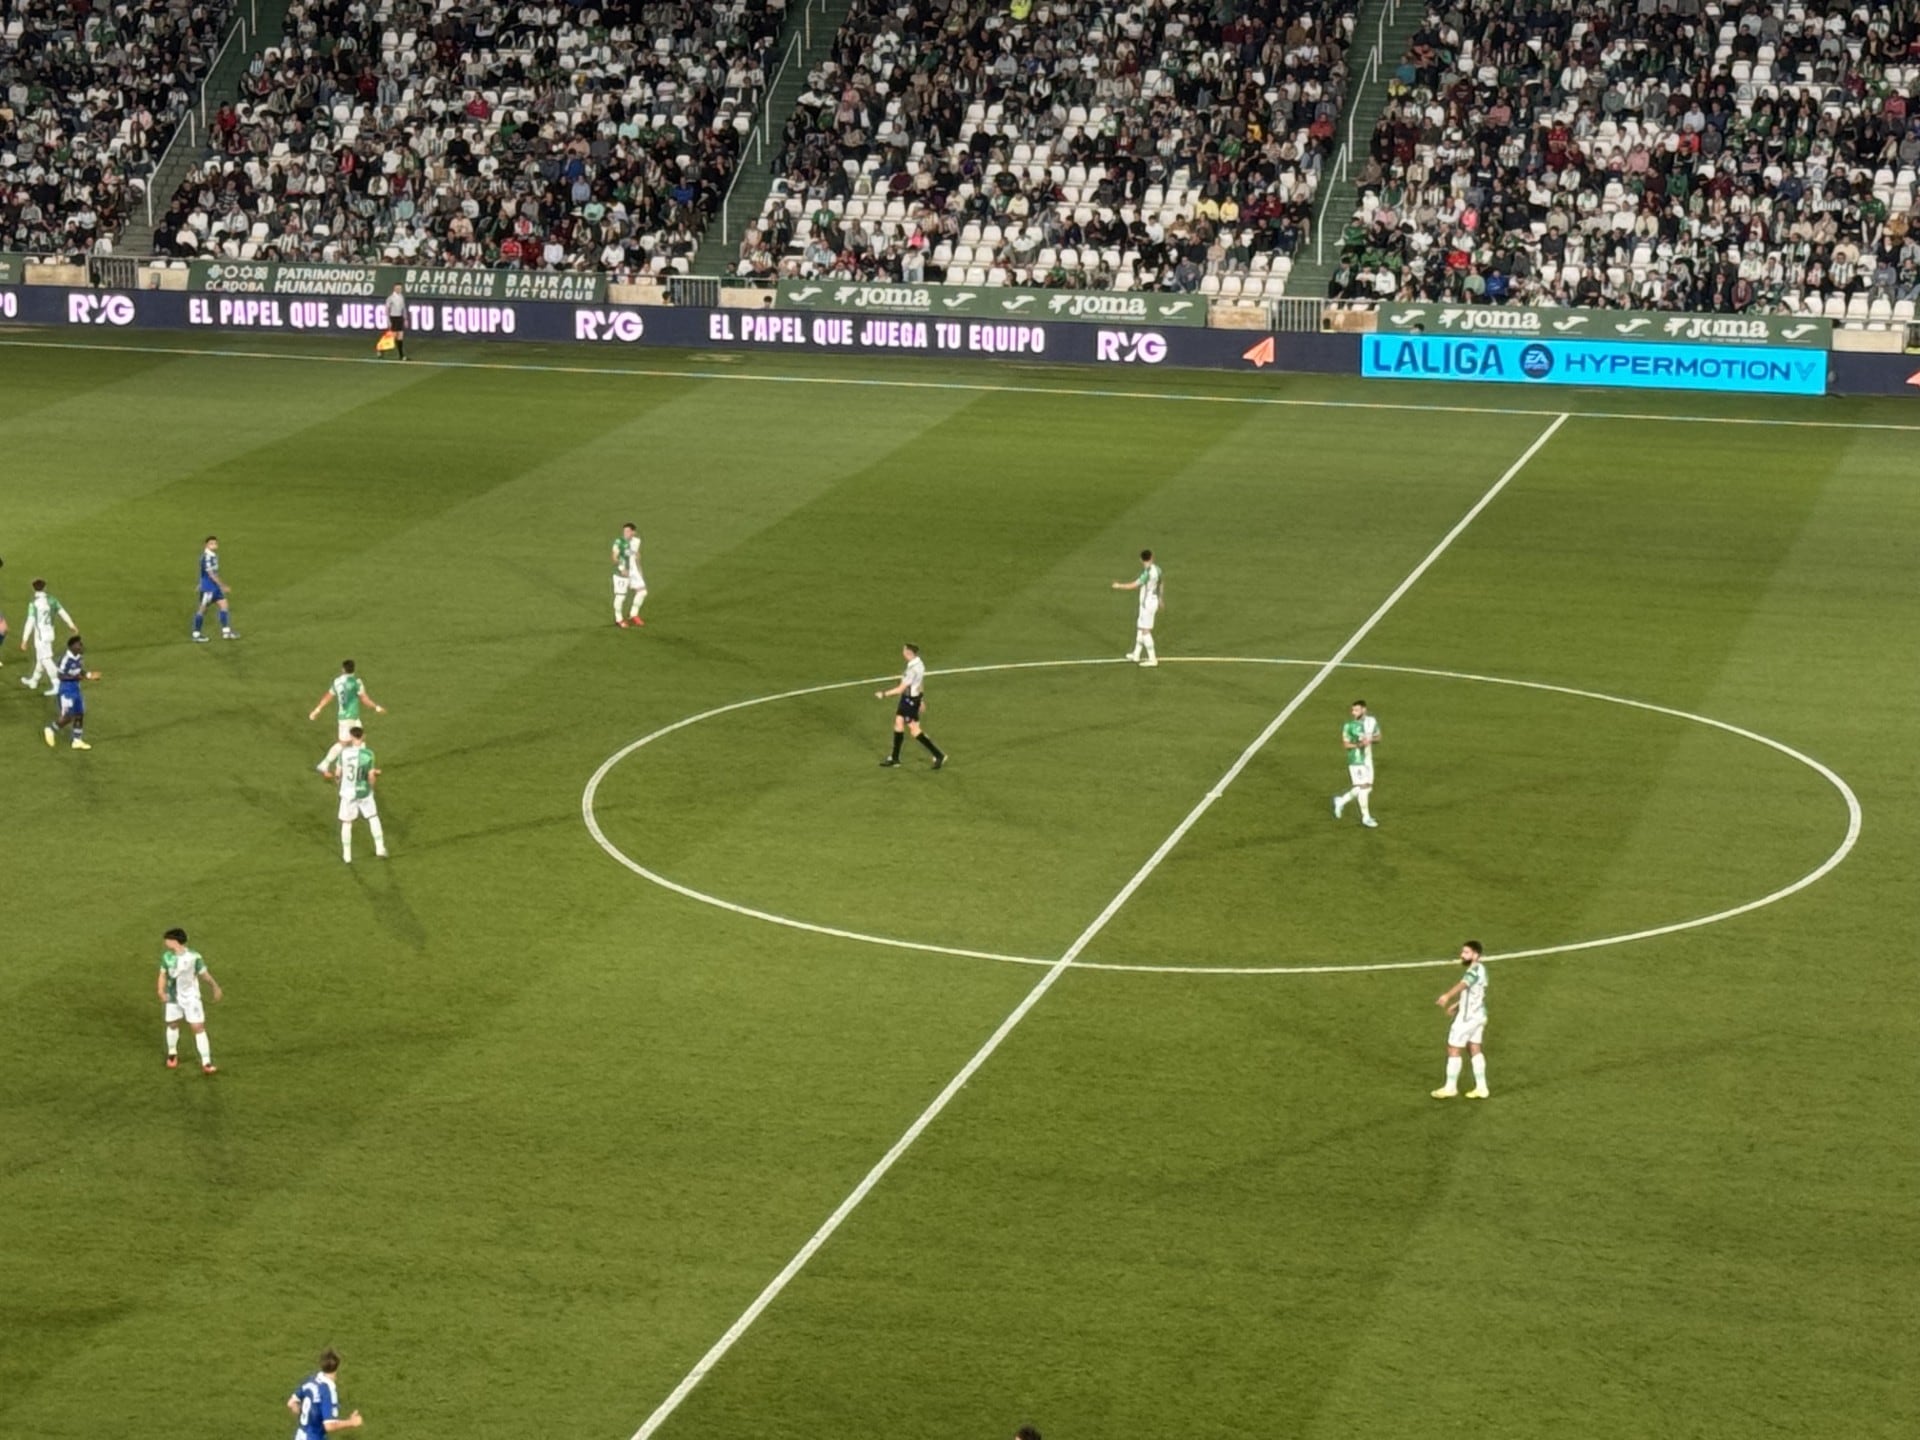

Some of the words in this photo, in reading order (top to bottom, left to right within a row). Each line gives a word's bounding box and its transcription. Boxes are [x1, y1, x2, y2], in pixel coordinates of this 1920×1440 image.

[277, 267, 365, 282] PATRIMONIO
[406, 270, 495, 286] BAHRAIN
[506, 274, 596, 290] BAHRAIN
[274, 280, 374, 296] HUMANIDAD
[404, 284, 492, 297] VICTORIOUS
[505, 288, 594, 301] VICTORIOUS
[68, 293, 135, 326] RYG
[189, 298, 213, 324] EL
[220, 299, 283, 326] PAPEL
[290, 302, 329, 328] QUE
[336, 303, 388, 329] JUEG
[409, 304, 434, 331] TU
[442, 306, 515, 334] EQUIPO
[575, 310, 644, 341] RYG
[709, 314, 734, 340] EL
[741, 315, 806, 343] PAPEL
[813, 318, 853, 346] QUE
[860, 321, 928, 348] JUEGA
[935, 323, 961, 349] TU
[969, 324, 1045, 353] EQUIPO
[1097, 330, 1167, 363] RYG
[1373, 340, 1504, 376] LALIGA
